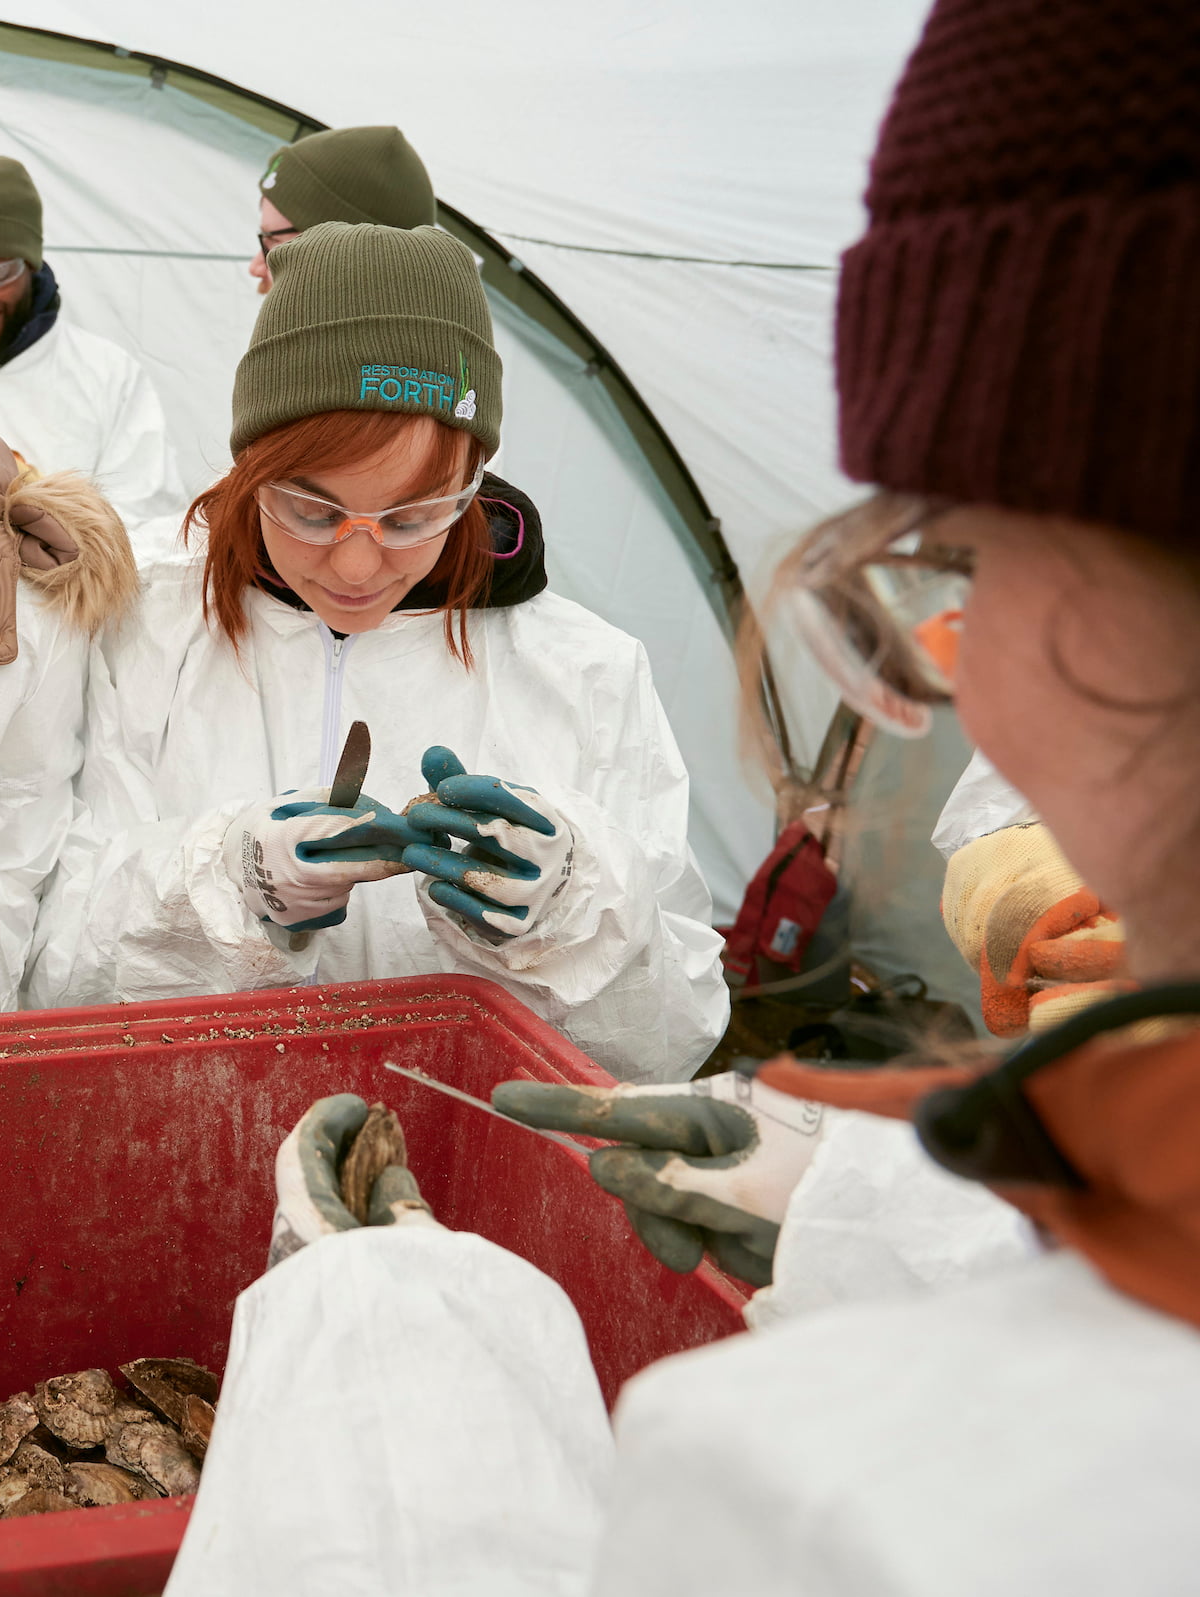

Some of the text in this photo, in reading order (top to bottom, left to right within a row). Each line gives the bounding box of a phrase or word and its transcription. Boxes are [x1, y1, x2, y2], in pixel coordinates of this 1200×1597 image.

[361, 364, 456, 387] RESTORATION
[360, 377, 456, 411] FORTH
[252, 836, 288, 912] site
